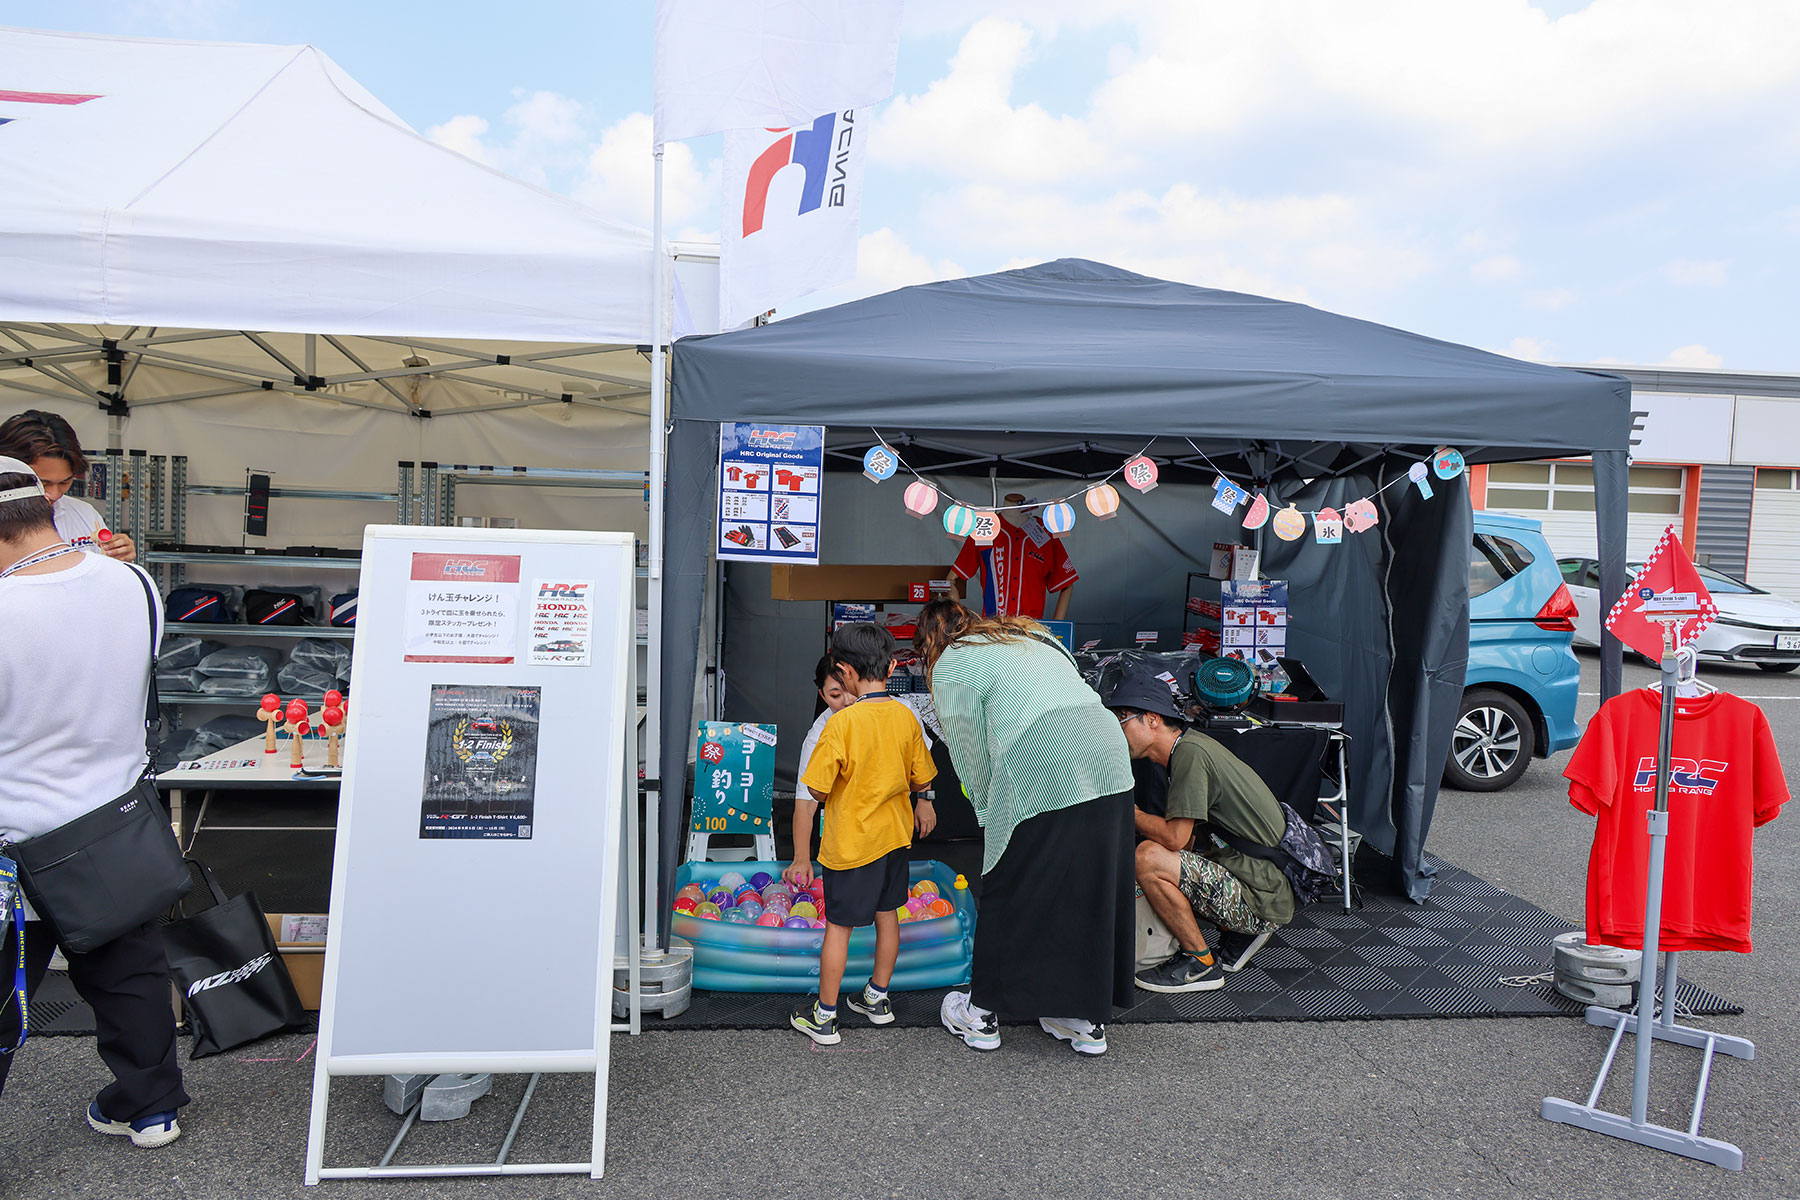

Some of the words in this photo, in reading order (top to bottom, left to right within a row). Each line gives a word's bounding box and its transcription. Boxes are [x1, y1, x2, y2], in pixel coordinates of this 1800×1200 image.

[748, 430, 797, 446] HRC
[756, 451, 781, 459] Original
[783, 452, 804, 460] Goods
[870, 451, 891, 474] 祭
[1131, 463, 1152, 484] 祭
[976, 517, 993, 536] 祭
[1322, 526, 1336, 539] 氷
[444, 559, 488, 572] HRC
[428, 593, 499, 603] けん玉チャレンジ！
[538, 583, 588, 598] HRC
[537, 603, 588, 611] HONDA
[458, 740, 475, 749] 1-2
[475, 740, 508, 750] Finish
[703, 743, 722, 760] 祭
[711, 769, 732, 805] 釣り
[18, 990, 28, 1030] MICHELIN
